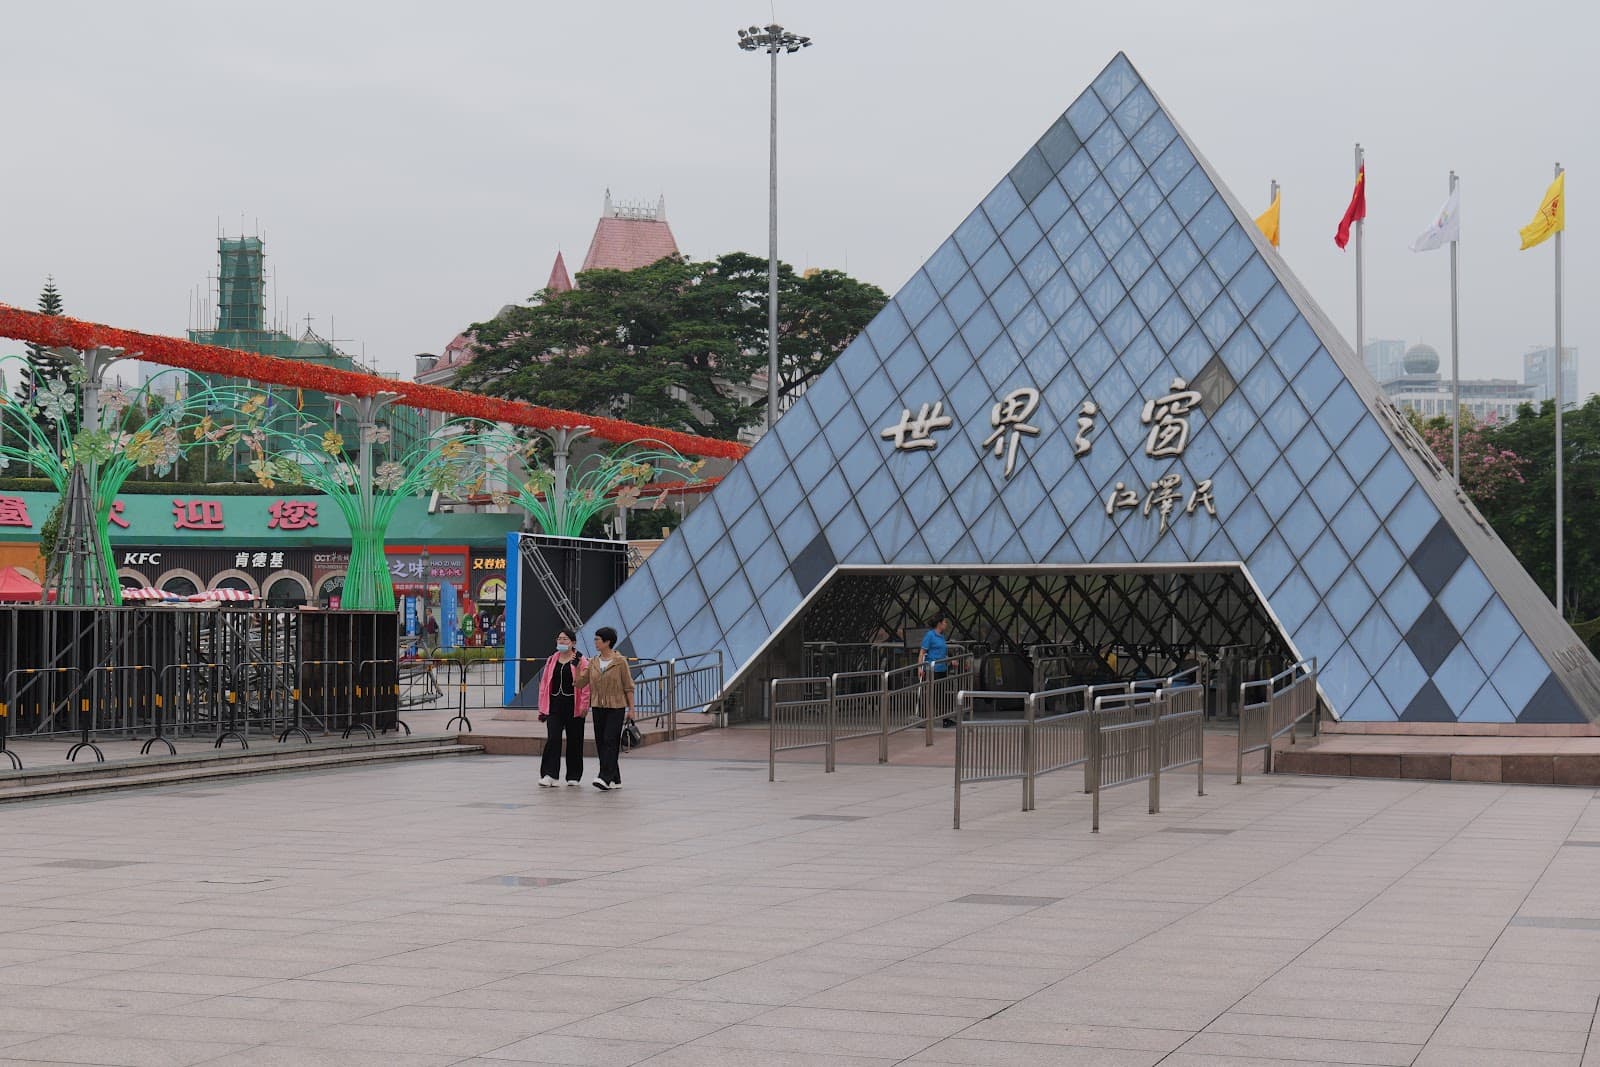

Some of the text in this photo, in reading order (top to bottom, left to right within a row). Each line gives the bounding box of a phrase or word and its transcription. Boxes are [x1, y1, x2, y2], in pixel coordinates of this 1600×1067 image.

[123, 552, 162, 566] KFC
[234, 551, 285, 569] 肯德基
[385, 558, 425, 579] 之味
